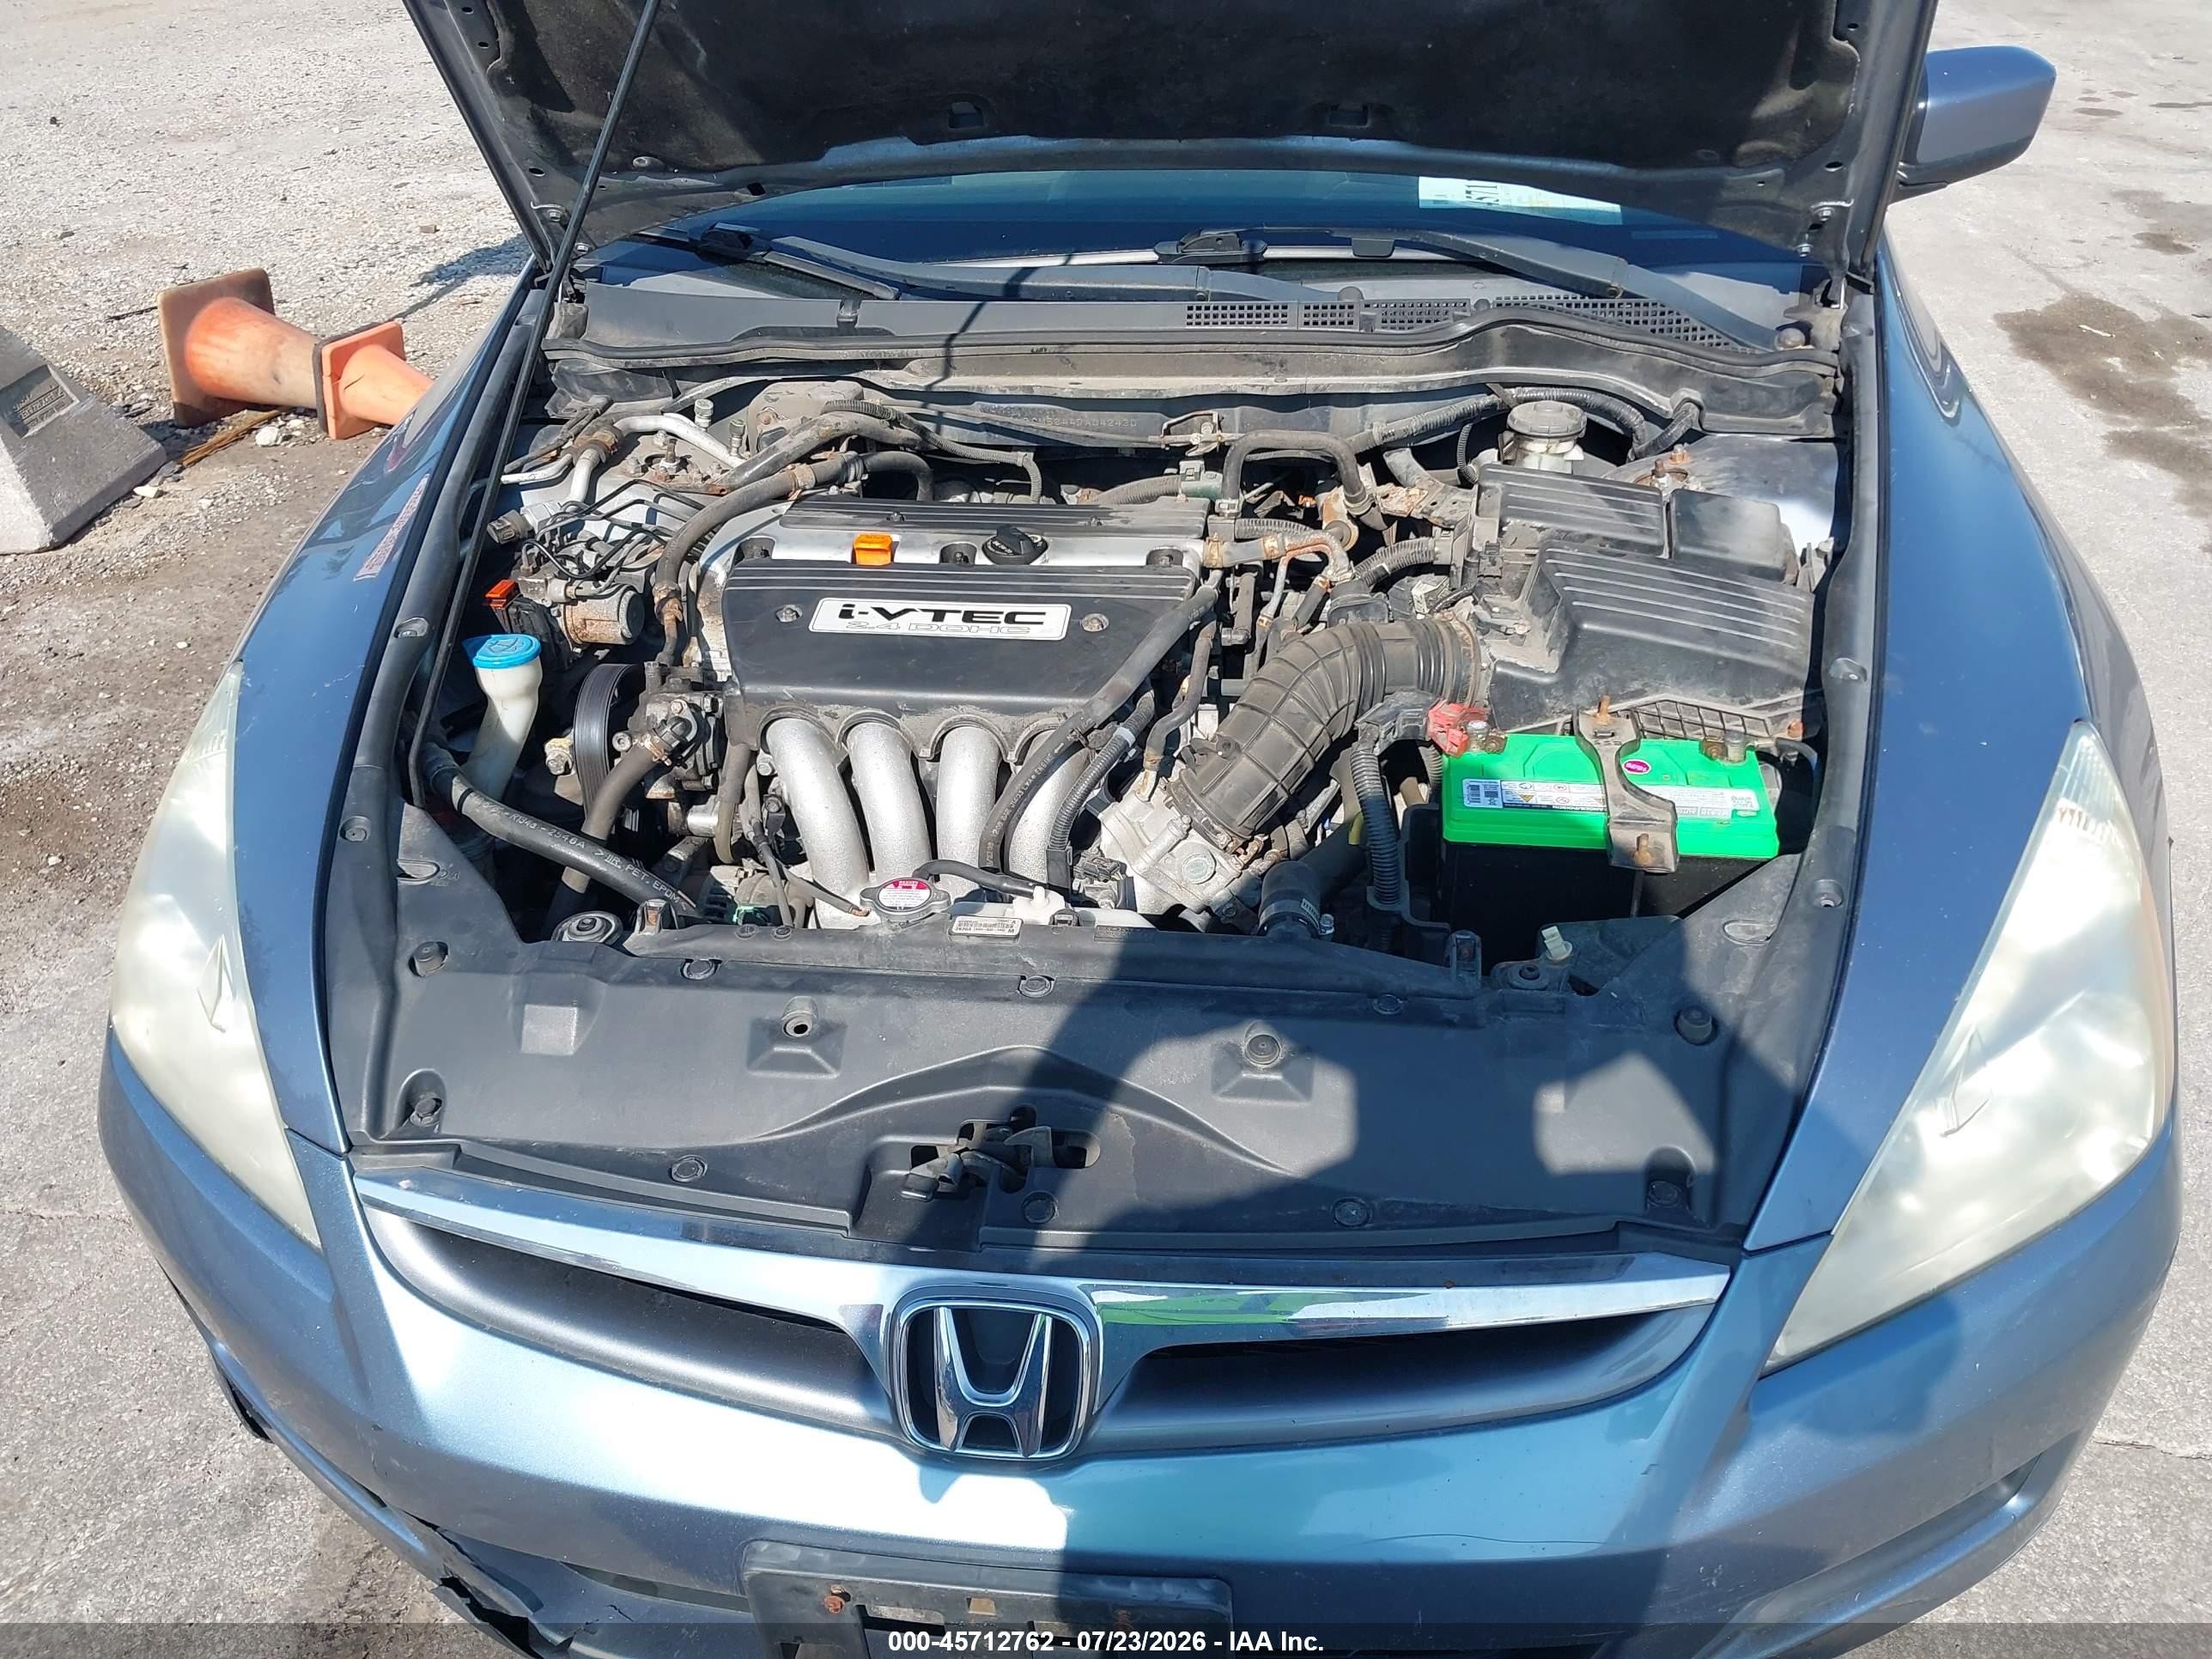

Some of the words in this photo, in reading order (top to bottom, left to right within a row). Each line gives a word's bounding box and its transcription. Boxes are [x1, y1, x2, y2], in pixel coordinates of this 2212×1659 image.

[838, 604, 1047, 625] i-VTEC
[846, 621, 900, 630] 2.4
[908, 623, 1030, 634] DOHC
